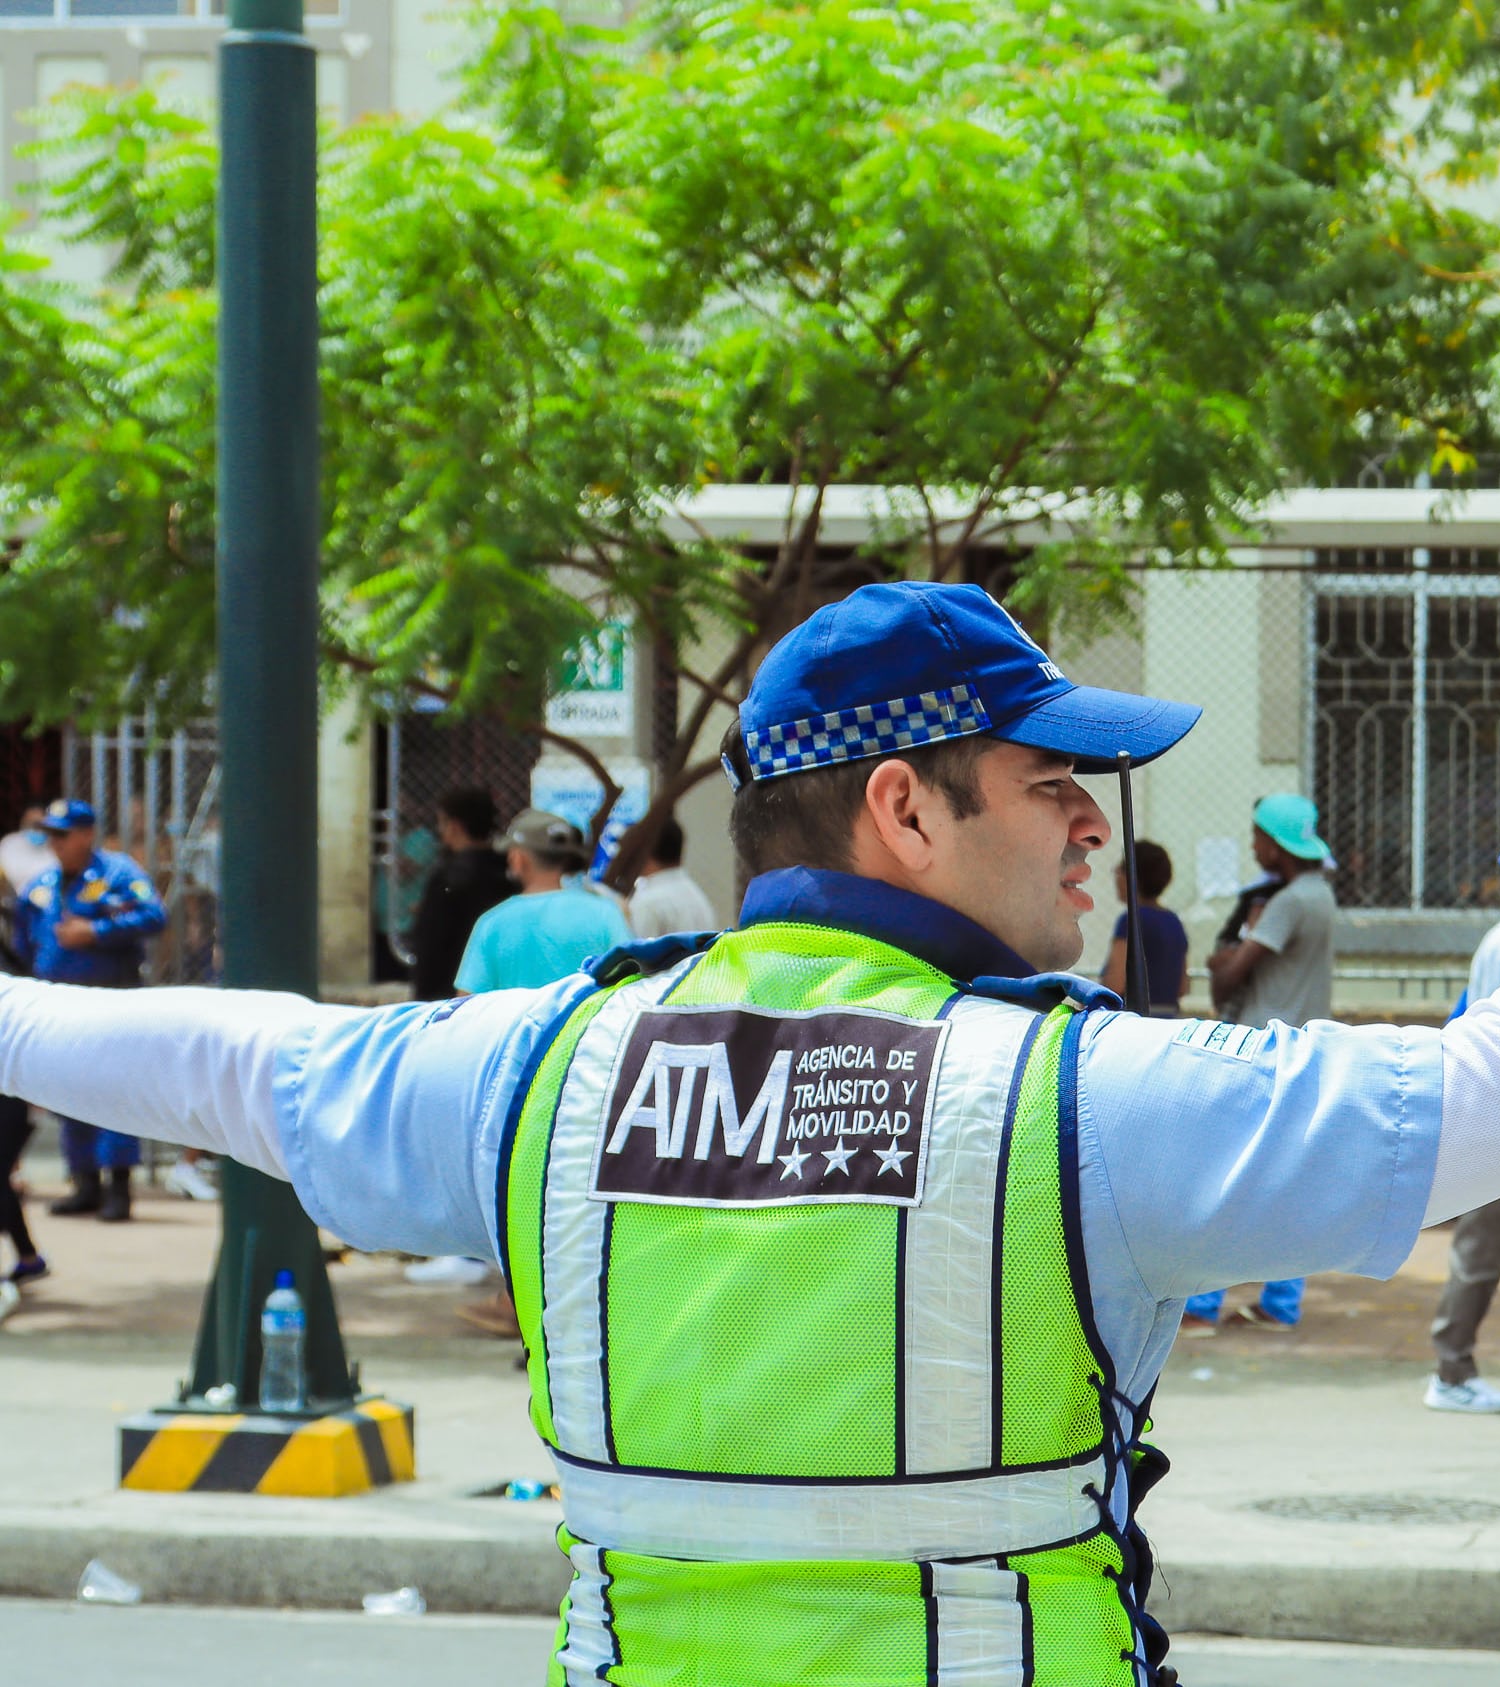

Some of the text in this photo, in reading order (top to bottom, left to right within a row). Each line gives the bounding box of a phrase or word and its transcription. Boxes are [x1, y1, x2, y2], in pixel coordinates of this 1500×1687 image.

[795, 1044, 917, 1075] AGENCIA DE
[606, 1040, 793, 1164] ATM
[793, 1070, 918, 1108] TRÁNSITO Y
[785, 1111, 911, 1141] MOVILIDAD
